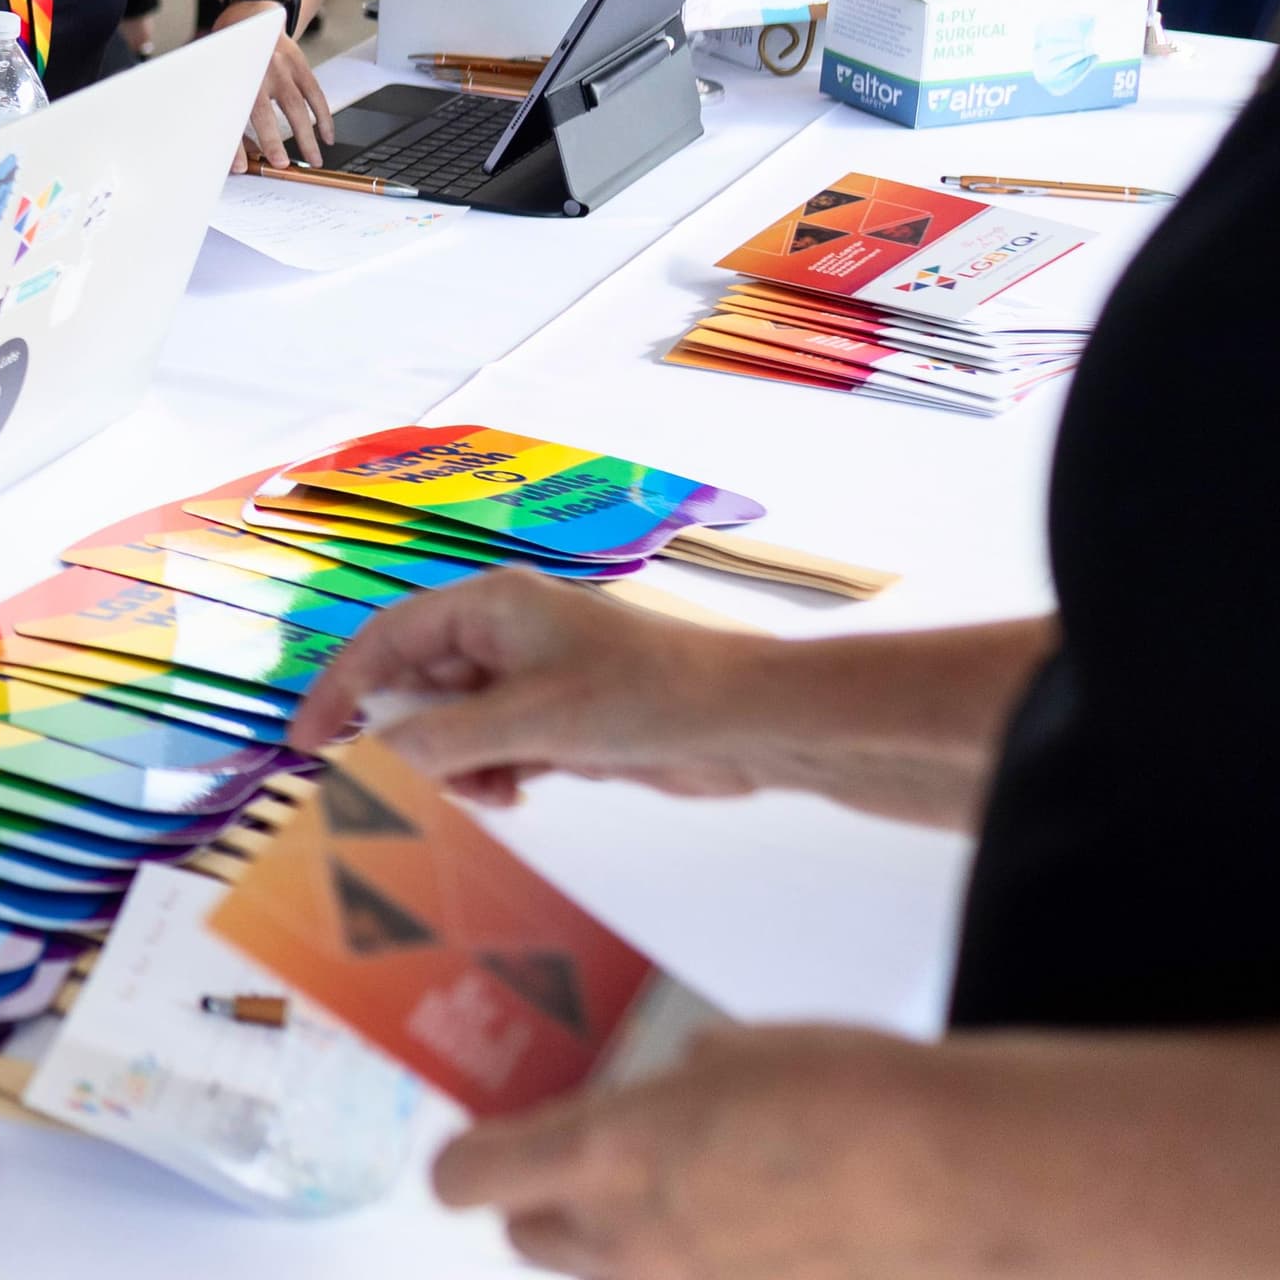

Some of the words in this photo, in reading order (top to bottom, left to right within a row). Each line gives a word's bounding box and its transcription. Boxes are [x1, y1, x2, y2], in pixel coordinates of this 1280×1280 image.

[852, 71, 903, 107] altor
[1114, 70, 1137, 90] 50
[949, 82, 1018, 112] altor
[338, 440, 474, 477] LGBTQ+
[388, 451, 517, 484] Health
